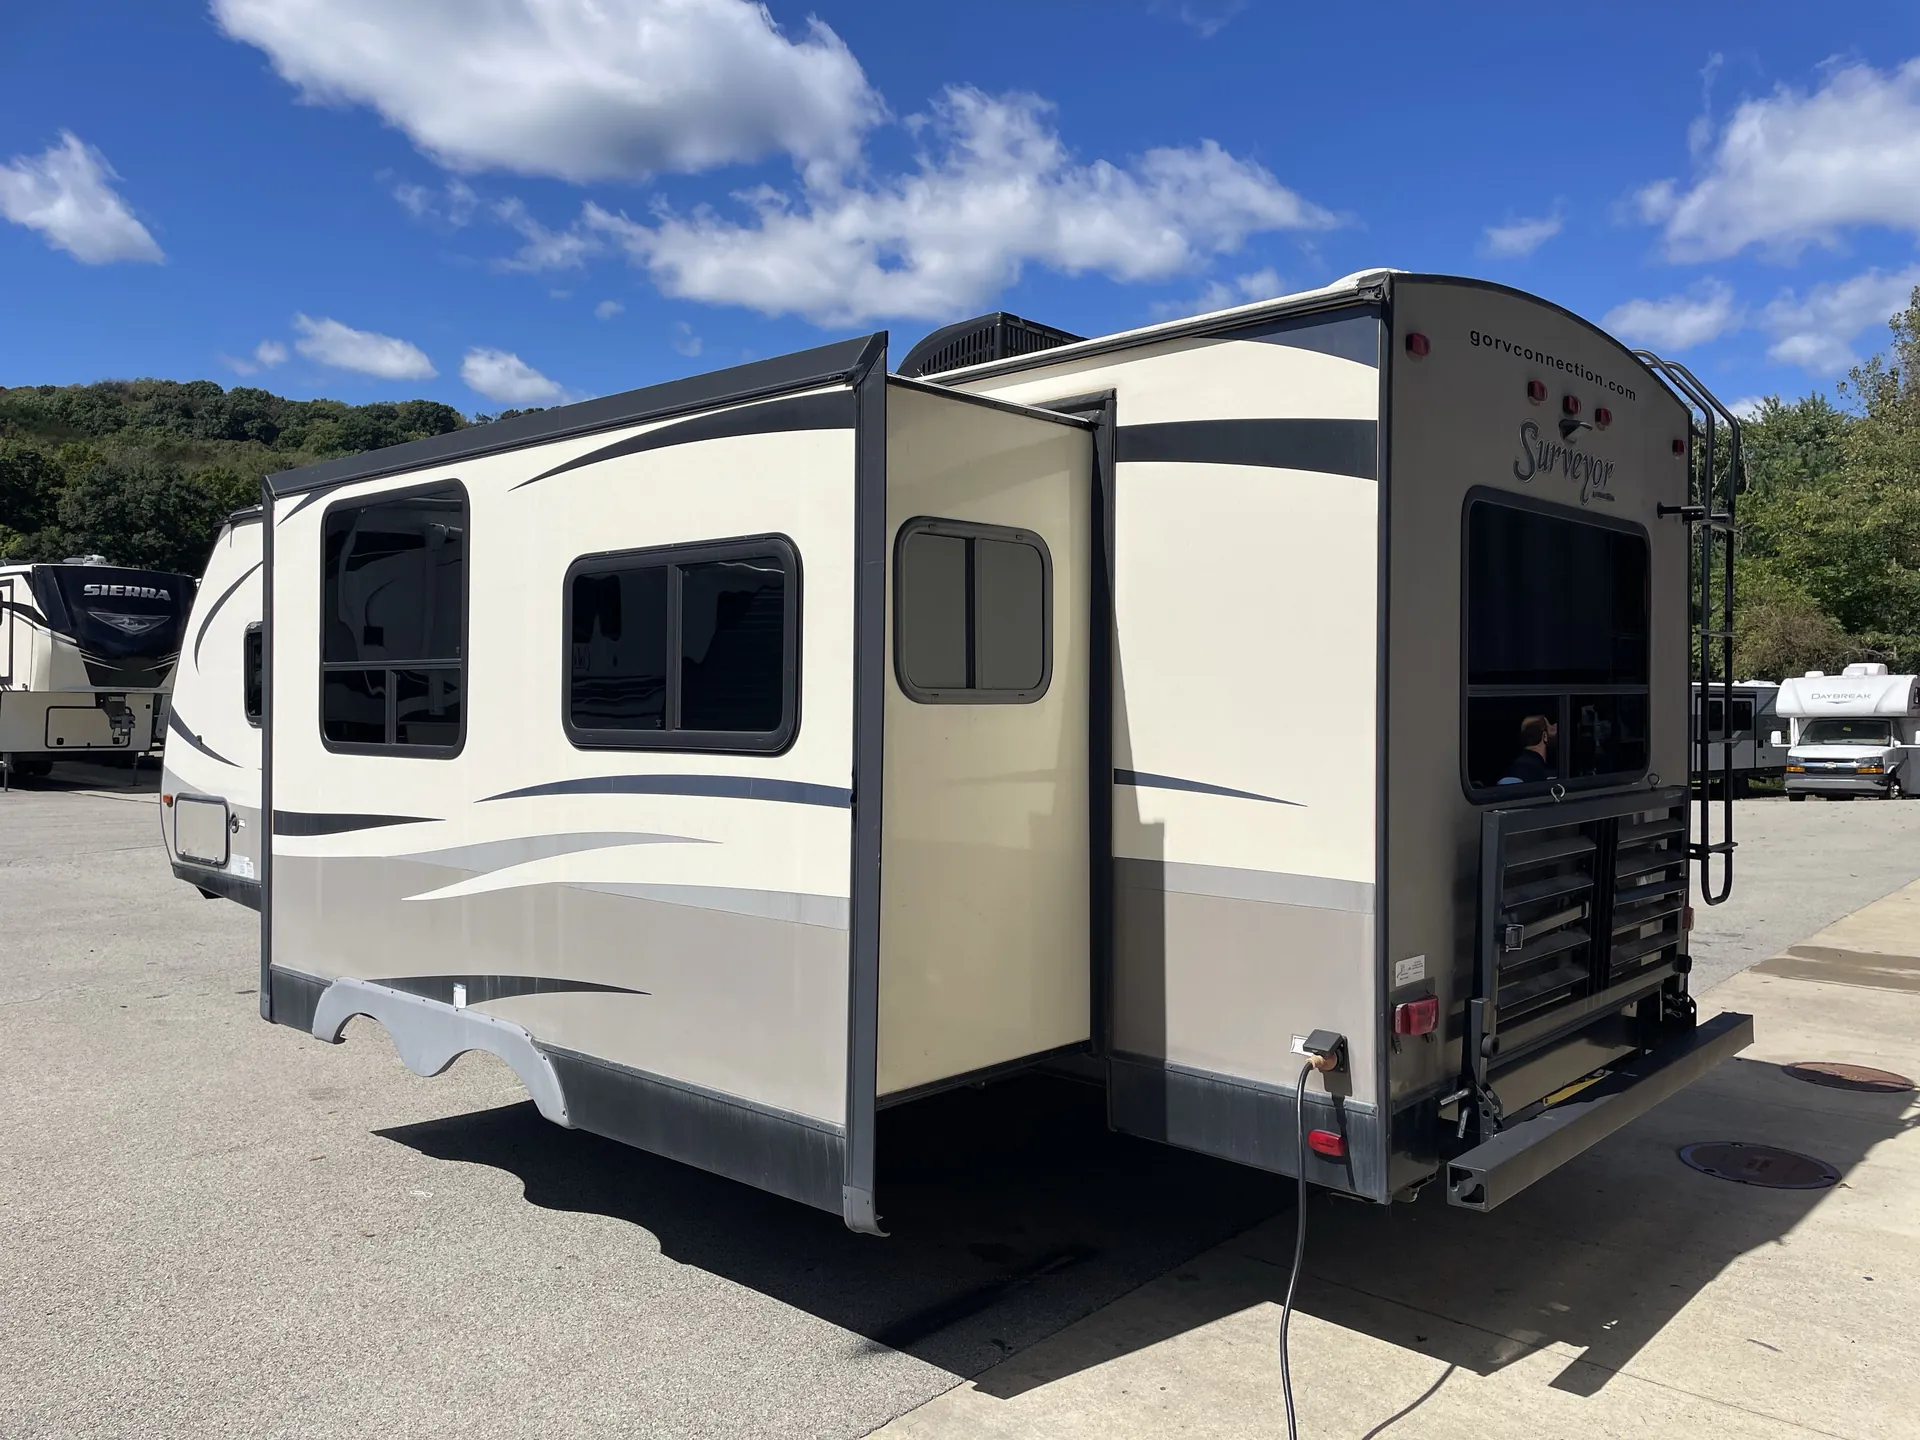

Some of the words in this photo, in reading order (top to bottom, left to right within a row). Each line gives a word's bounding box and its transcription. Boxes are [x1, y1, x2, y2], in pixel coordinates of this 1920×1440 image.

[1470, 330, 1636, 401] gorvconnection.com
[1513, 418, 1616, 505] Surveyor
[83, 584, 172, 601] SIERRA
